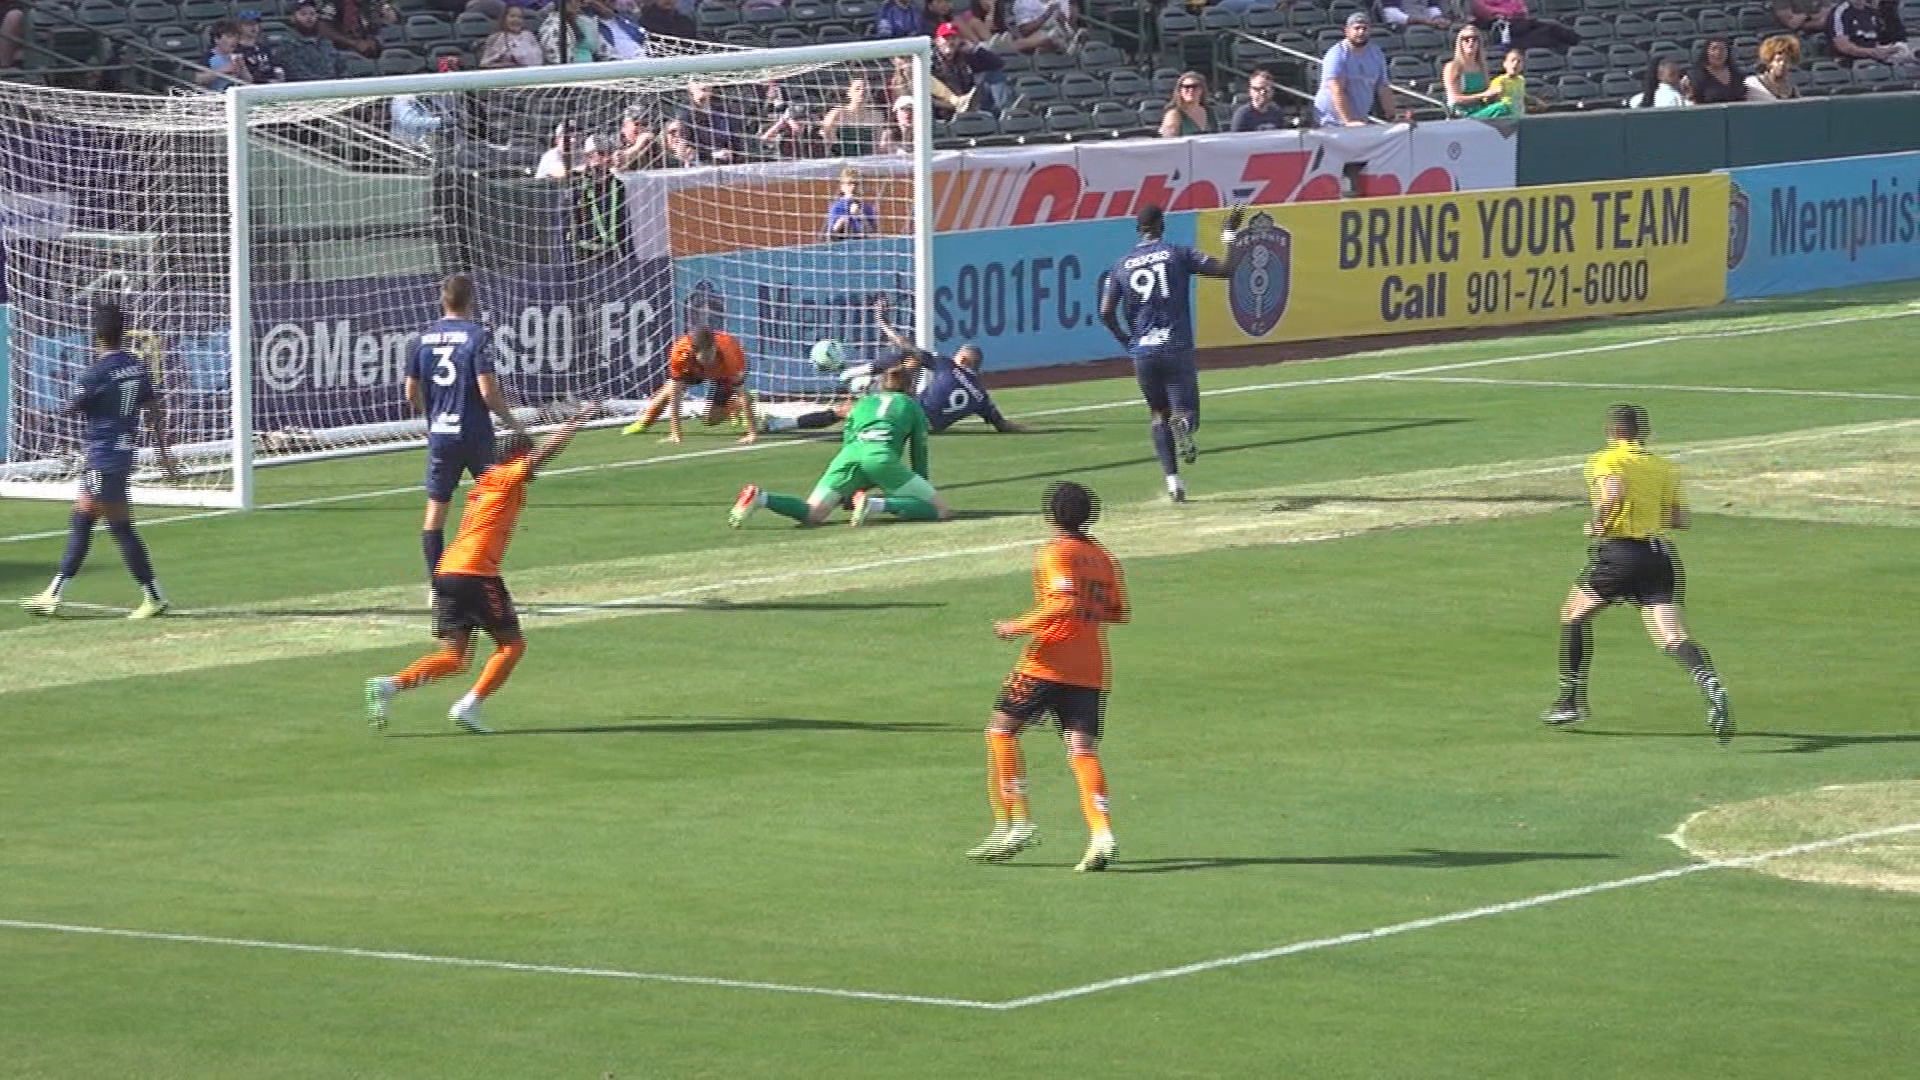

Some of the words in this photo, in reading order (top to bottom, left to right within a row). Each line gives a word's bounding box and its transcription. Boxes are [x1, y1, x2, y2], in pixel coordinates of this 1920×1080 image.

[1339, 202, 1460, 270] BRING
[1477, 194, 1576, 259] YOUR
[1591, 186, 1691, 251] TEAM
[1770, 176, 1920, 262] Memphis
[1129, 262, 1170, 303] 91
[1380, 271, 1447, 322] Call
[1467, 259, 1650, 315] 901-721-6000
[432, 346, 457, 387] 3
